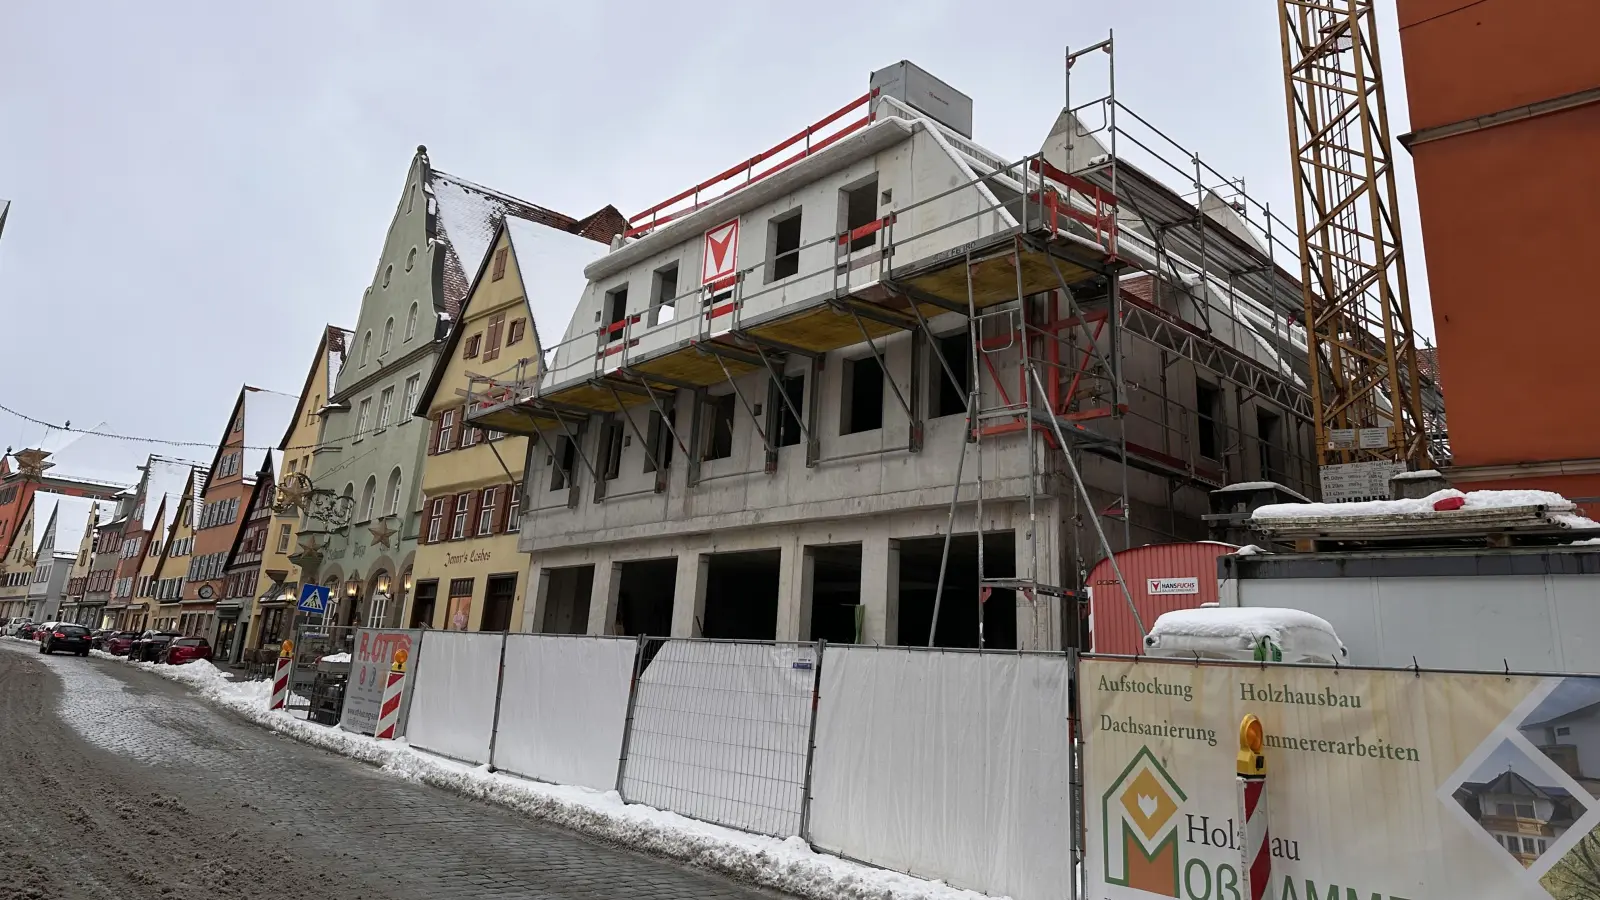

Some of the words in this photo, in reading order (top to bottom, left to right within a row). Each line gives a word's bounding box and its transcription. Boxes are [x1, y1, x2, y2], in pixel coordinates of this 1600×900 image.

[1098, 675, 1193, 701] Aufstockung
[1240, 683, 1361, 708] Holzhausbau
[1100, 714, 1217, 746] Dachsanierung
[1263, 733, 1420, 762] mmererarbeiten
[1185, 814, 1300, 861] Holau
